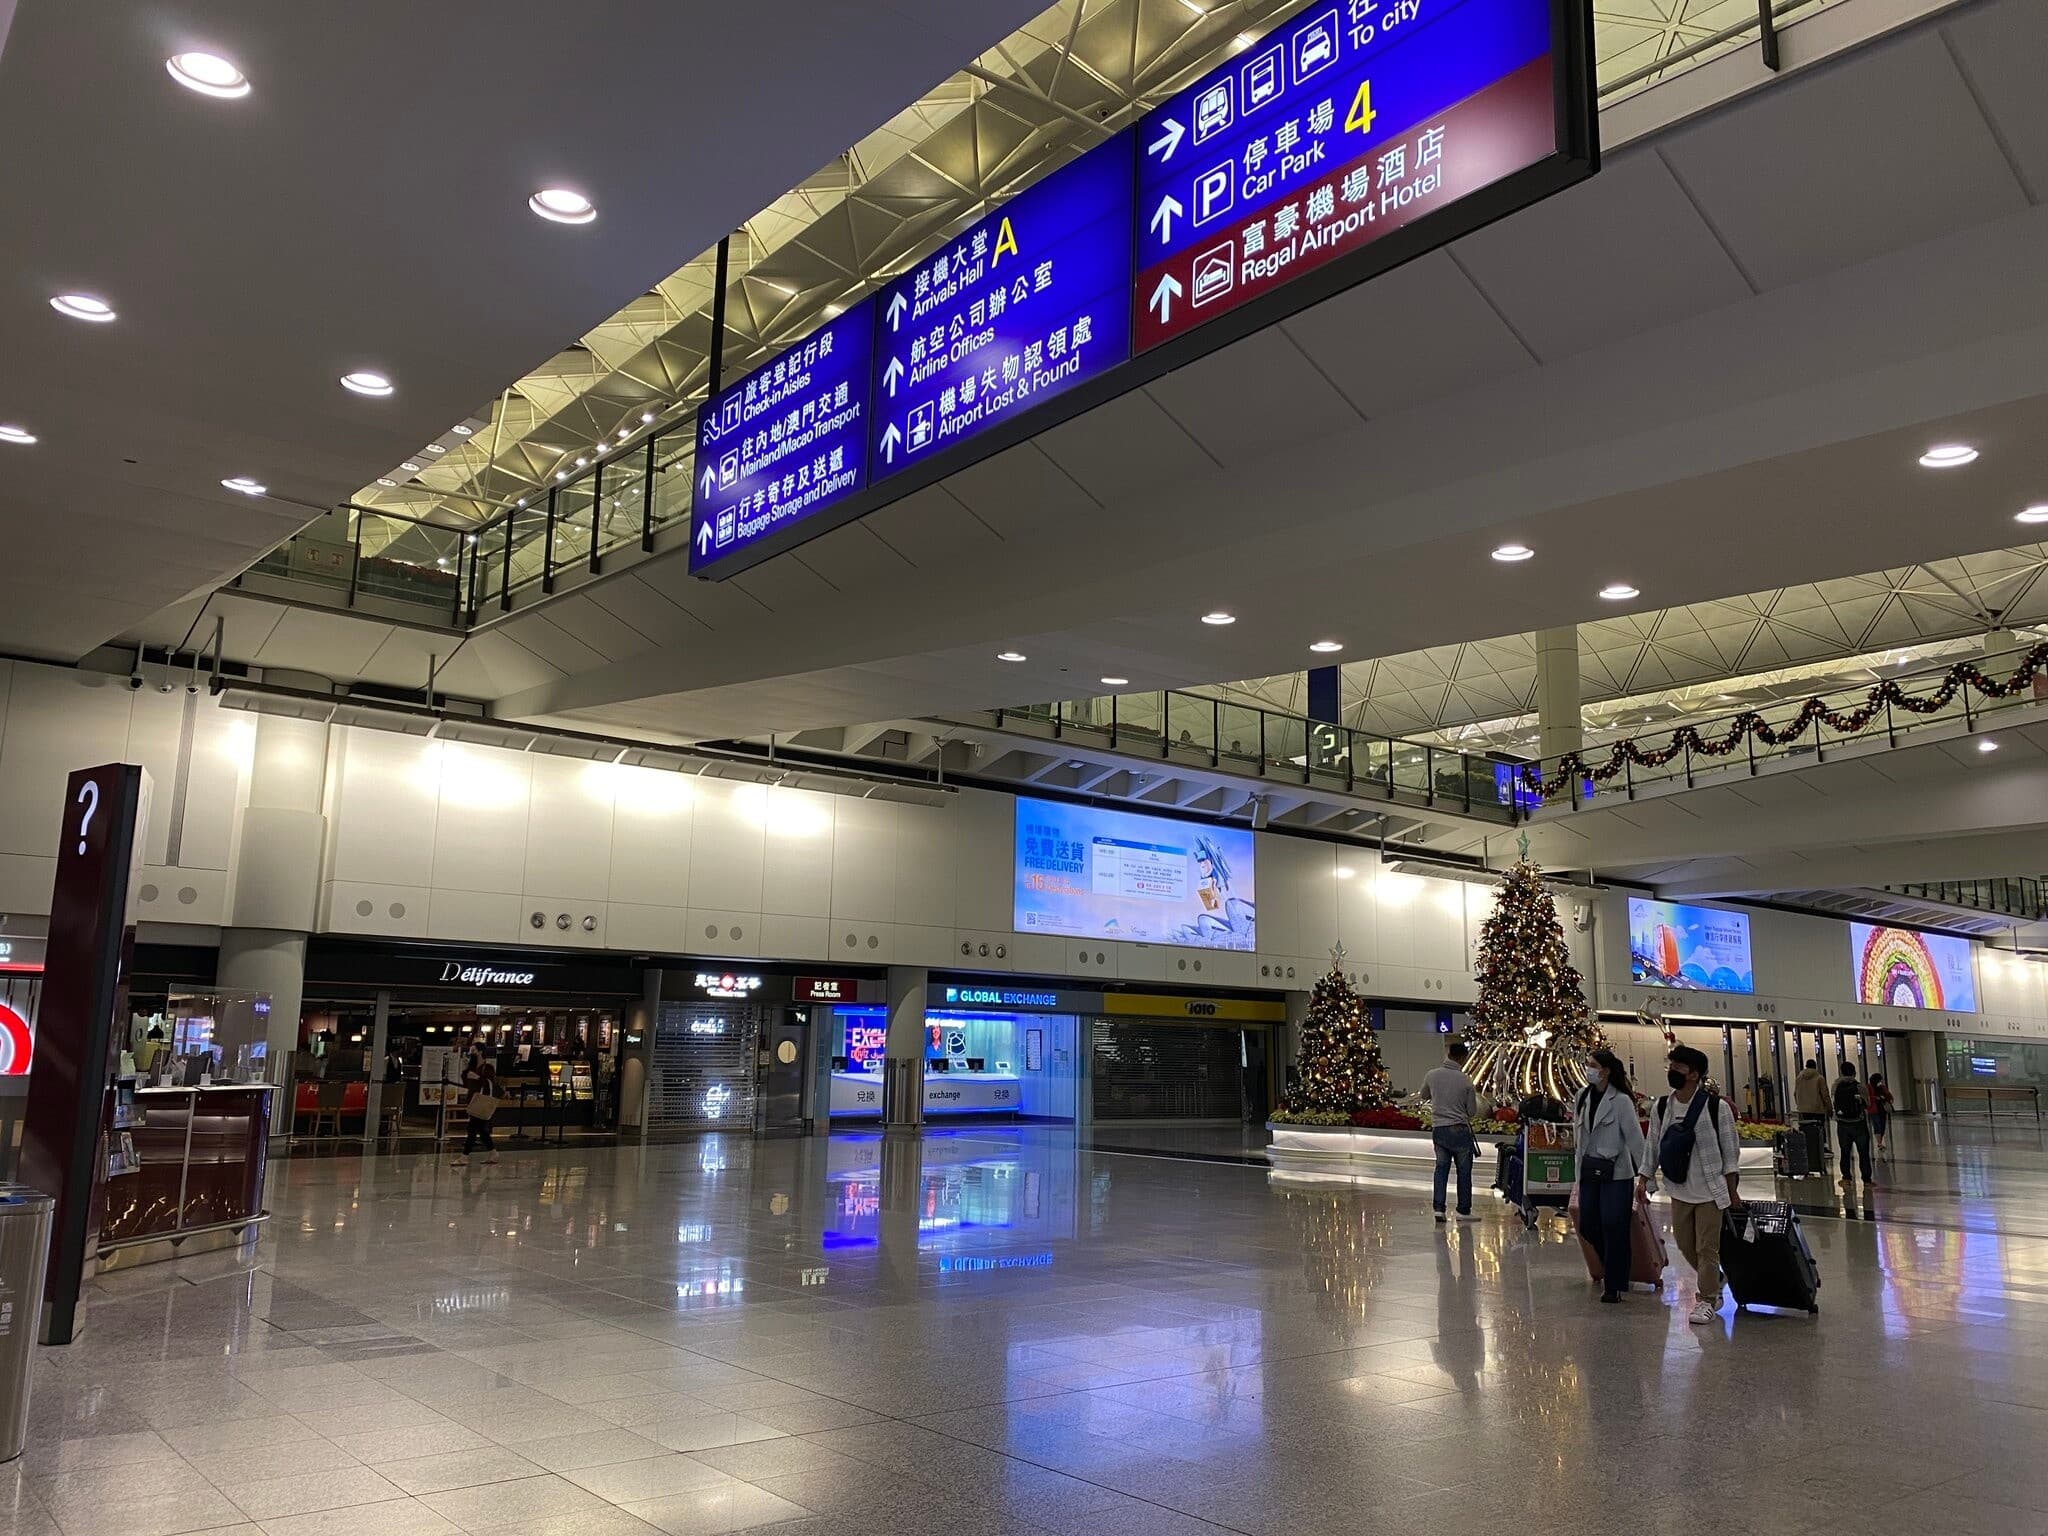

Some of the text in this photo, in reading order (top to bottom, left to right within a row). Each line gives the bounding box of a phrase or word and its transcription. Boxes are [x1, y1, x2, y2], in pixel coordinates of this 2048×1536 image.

[1347, 0, 1420, 50] To city
[1242, 79, 1377, 175] 停車場 4
[1242, 140, 1325, 200] Car Park
[1242, 125, 1446, 258] 富豪機場酒店
[914, 216, 1018, 300] 接機大堂 A
[1241, 163, 1442, 285] Regal Airport Hotel
[910, 260, 1053, 366] 航空公司辦公室
[912, 259, 983, 321] Arrivals Hall
[744, 331, 833, 403] 旅客登記行段
[909, 326, 994, 387] Airline Offices
[938, 315, 1093, 417] 機場失物認領處
[725, 399, 740, 422] T1
[743, 372, 811, 422] Check-in Aisles
[937, 351, 1080, 439] Airport Lost & Found
[740, 401, 861, 480] Mainland/Macao Transport
[737, 468, 857, 539] Baggage Storage and Delivery
[738, 446, 844, 521] 行李寄存及送遞
[1025, 856, 1084, 874] FREE DELIVERY
[439, 962, 534, 986] Délifrance
[960, 990, 1056, 1006] GLOBAL EXCHANGE
[929, 1090, 961, 1100] exchange
